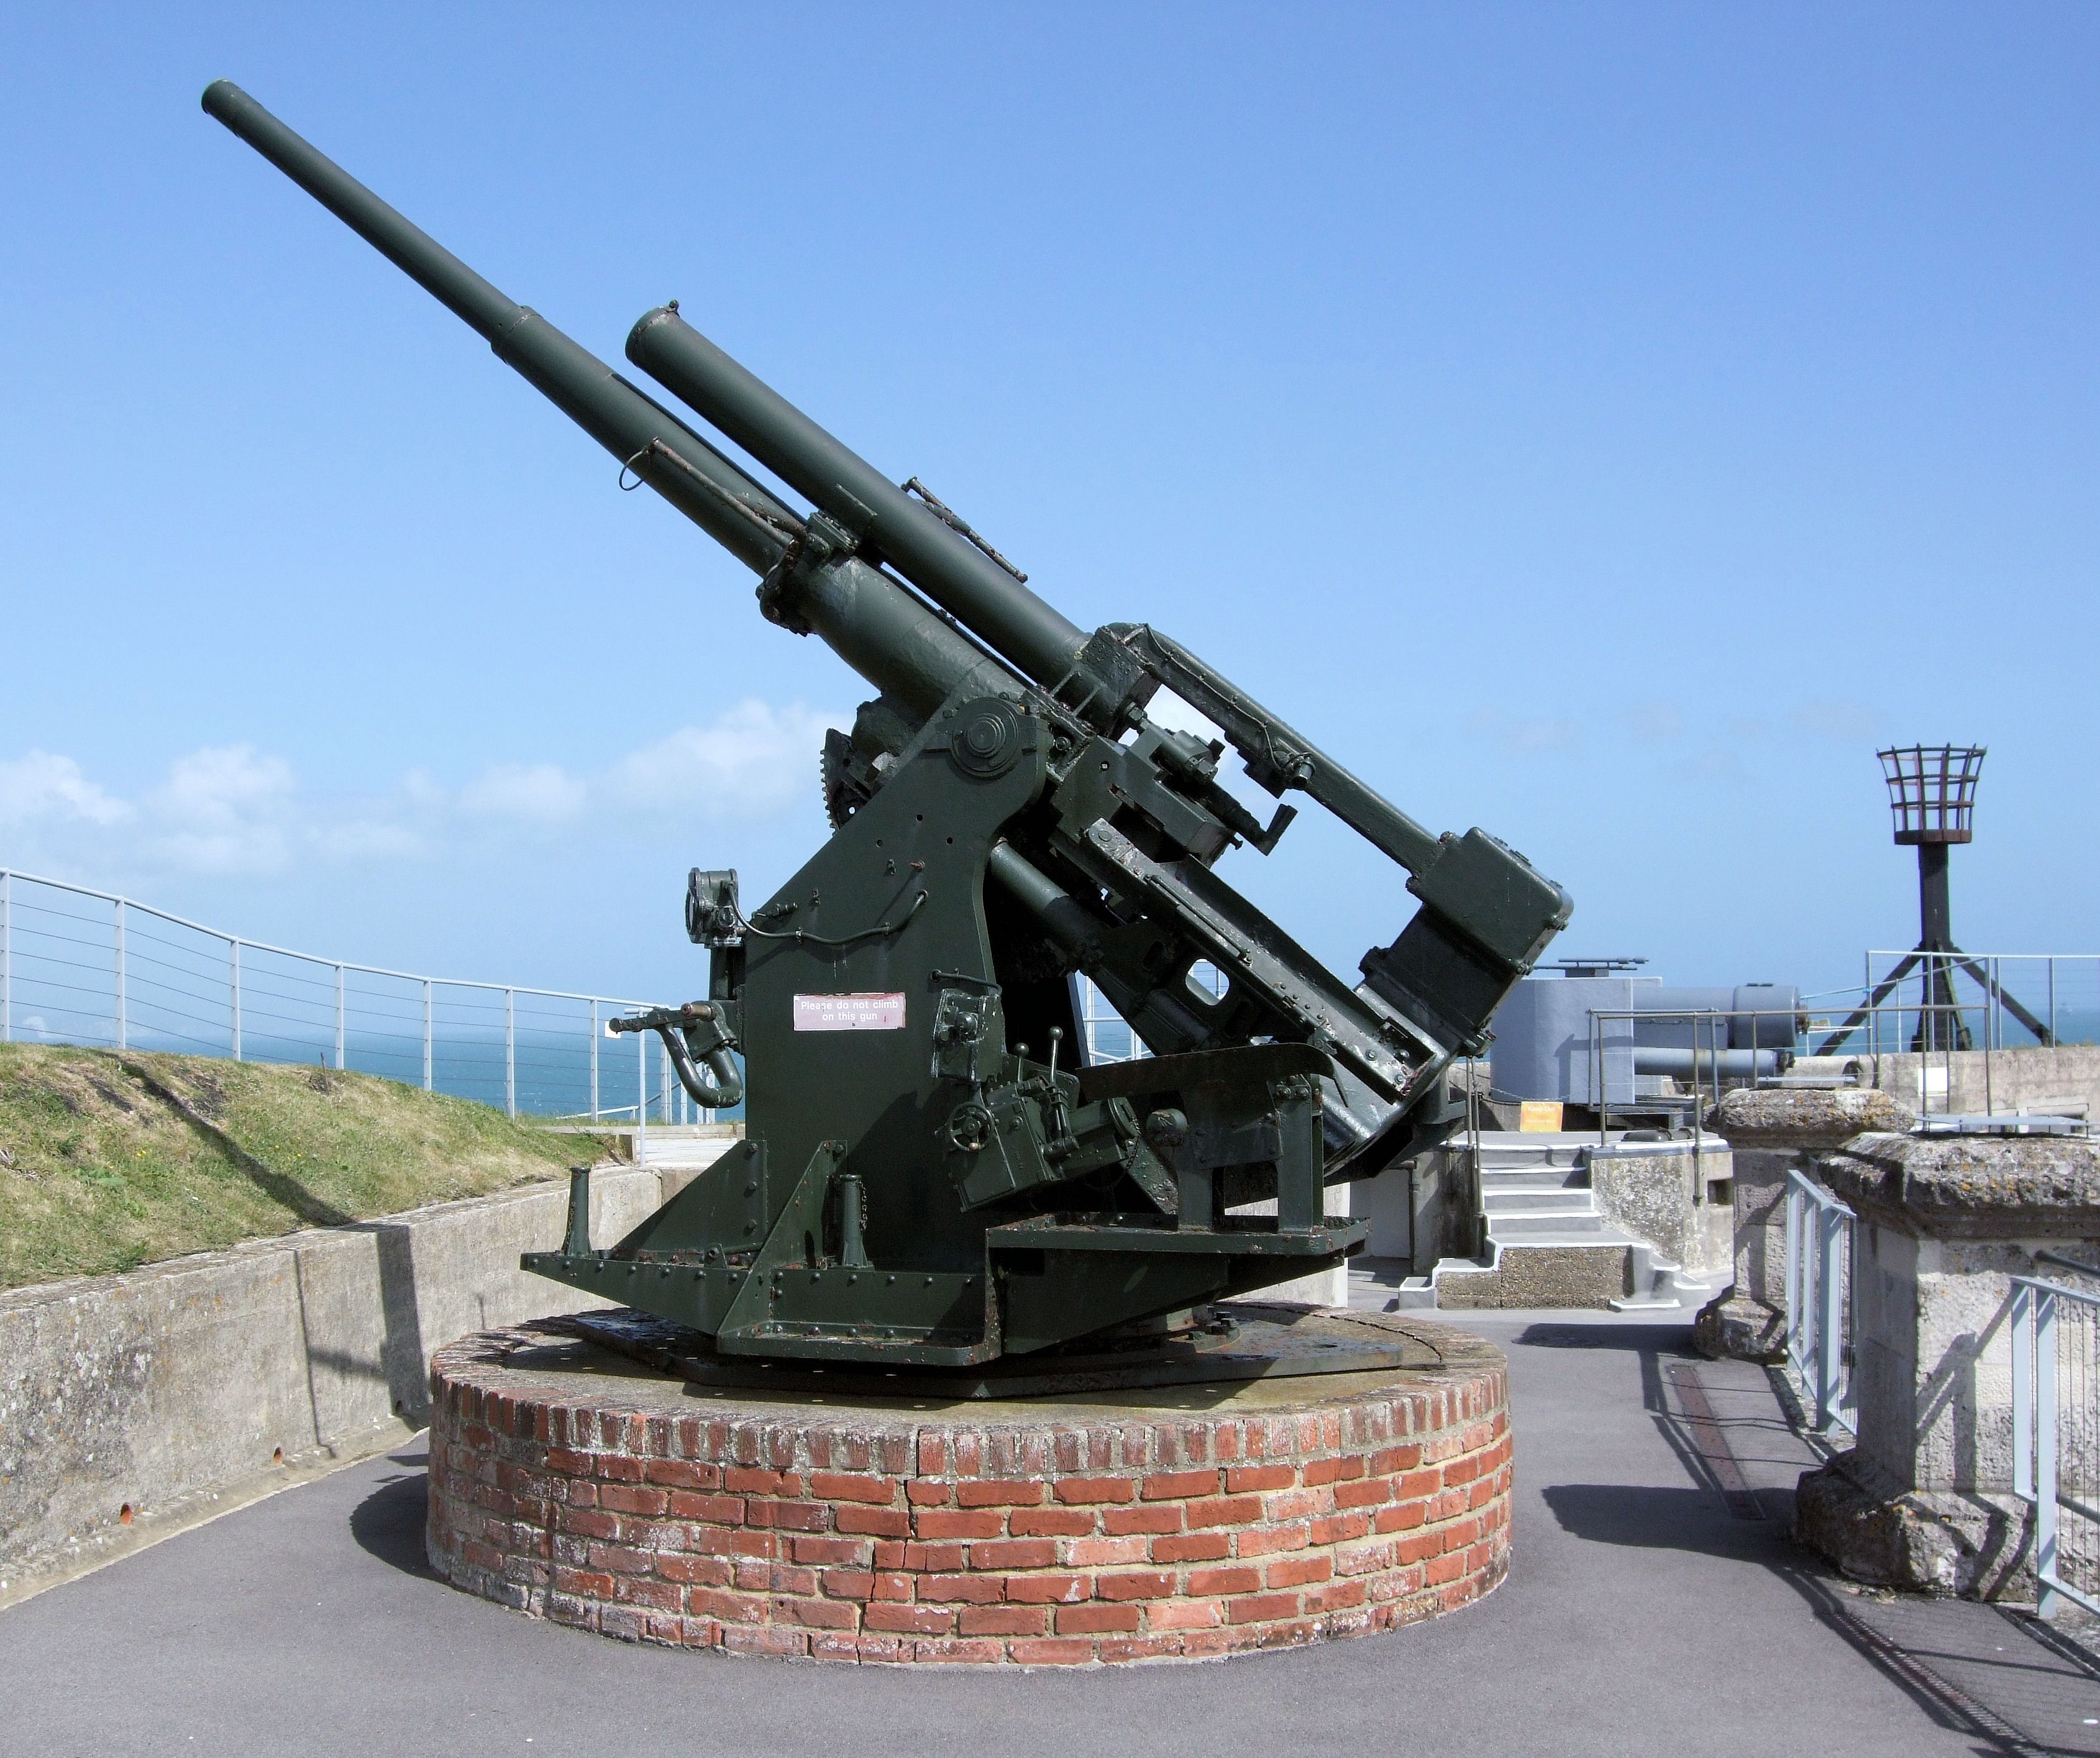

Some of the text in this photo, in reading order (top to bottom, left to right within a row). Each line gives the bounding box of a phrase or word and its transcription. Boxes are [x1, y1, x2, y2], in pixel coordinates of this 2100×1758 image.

[801, 1000, 898, 1010] Please do not climb
[839, 1013, 856, 1021] this
[860, 1013, 877, 1022] gun
